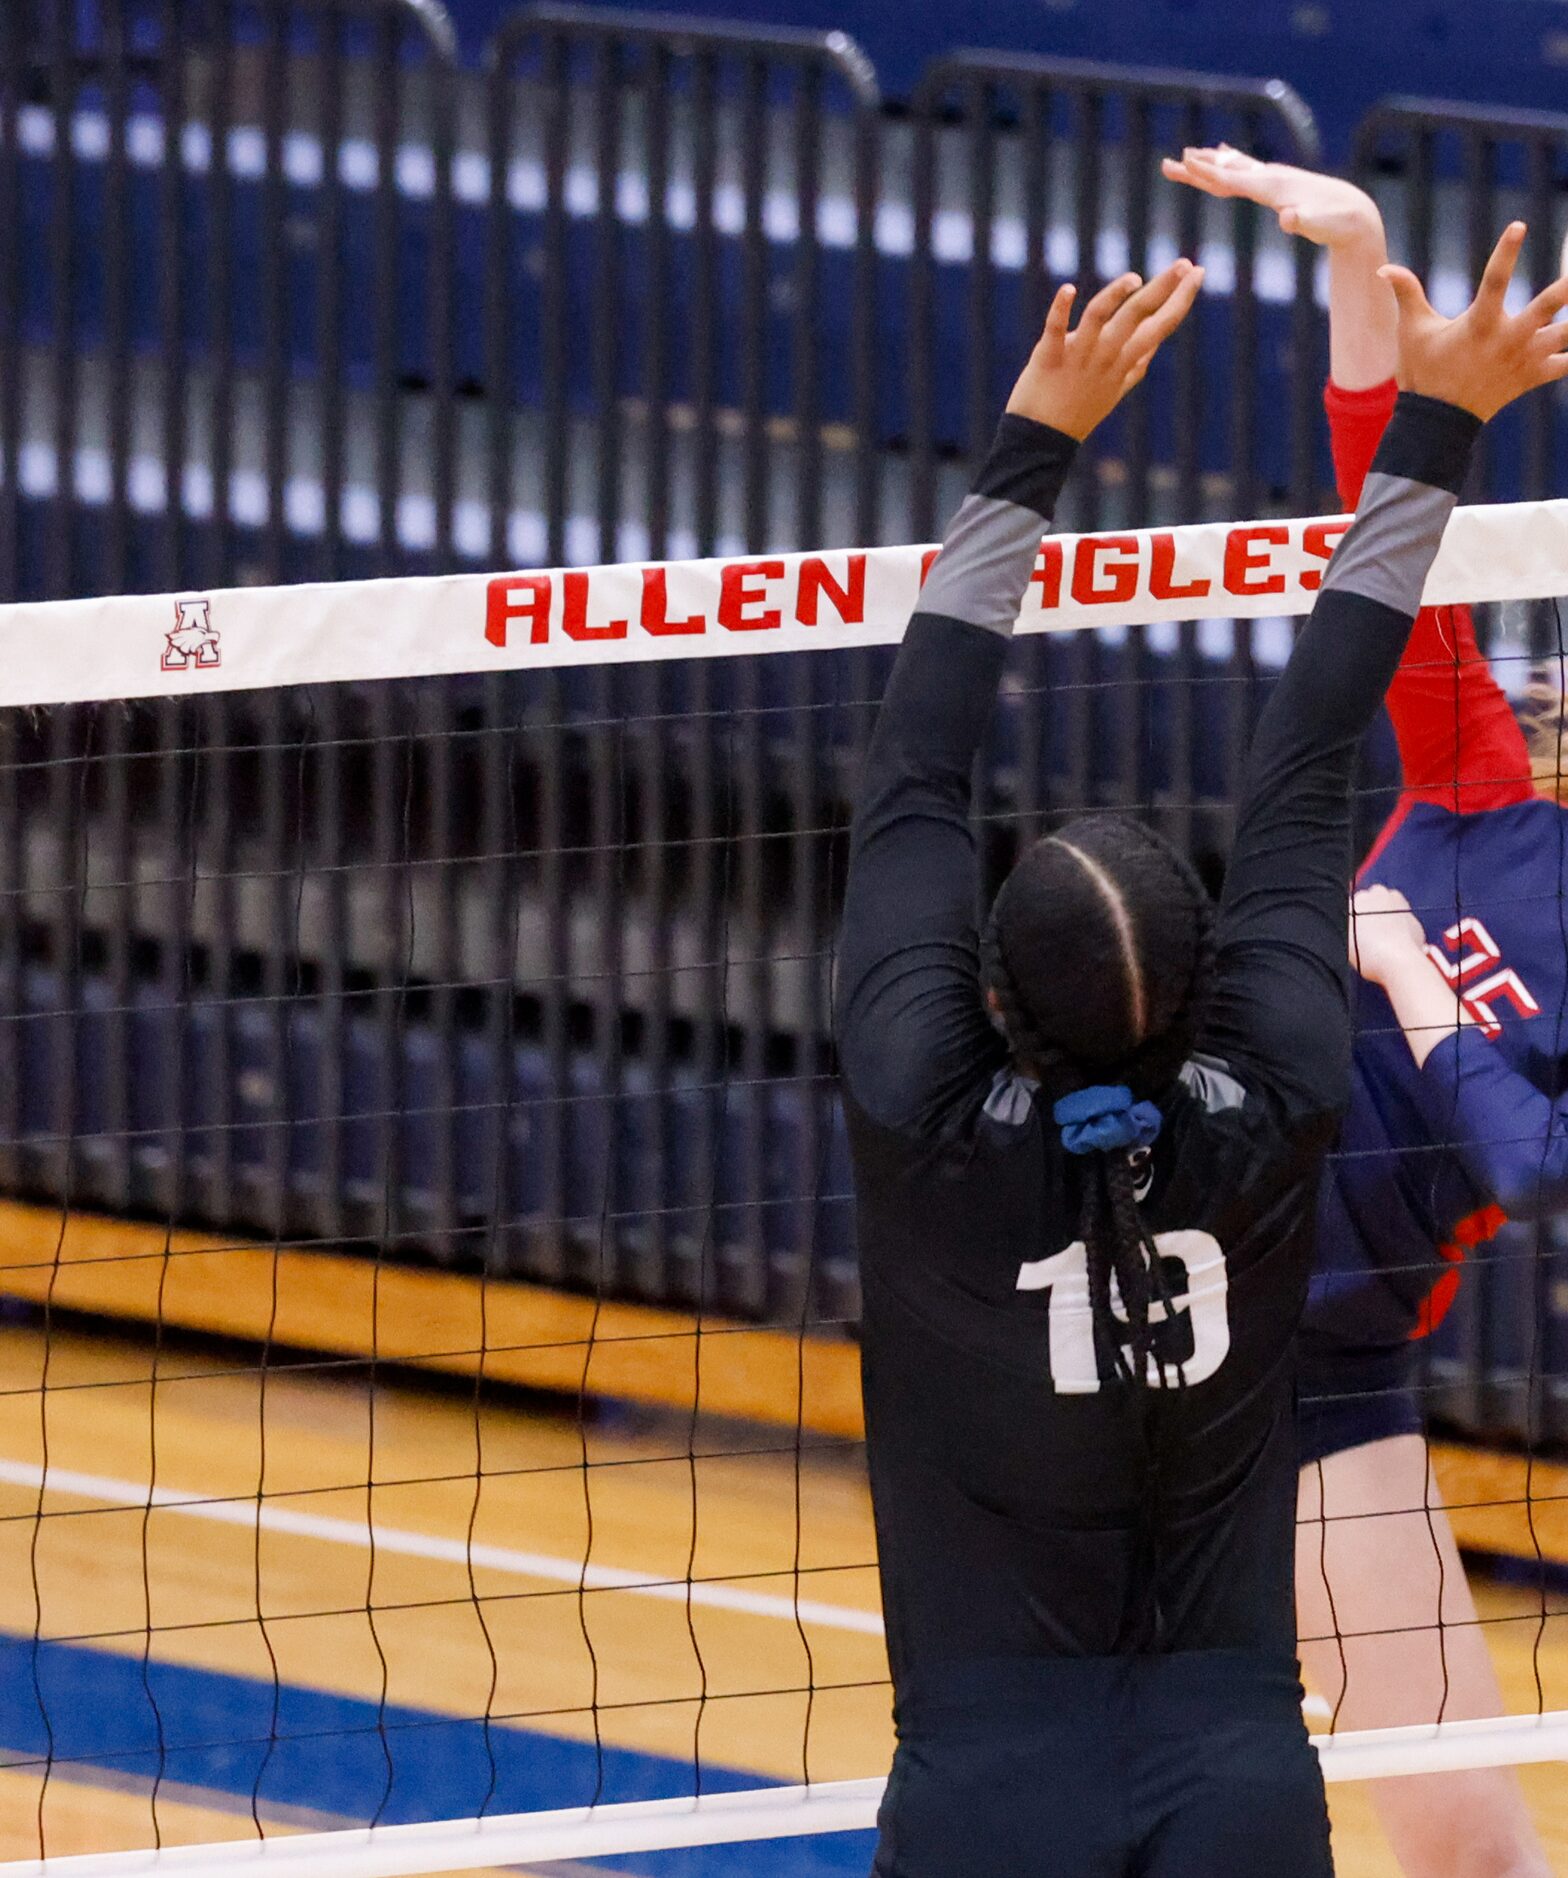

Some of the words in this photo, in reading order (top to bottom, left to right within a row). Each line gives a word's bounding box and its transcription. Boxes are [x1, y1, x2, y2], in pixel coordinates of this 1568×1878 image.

[484, 553, 867, 649] ALLEN
[920, 520, 1356, 610] AGLES
[1016, 1228, 1231, 1395] 19
